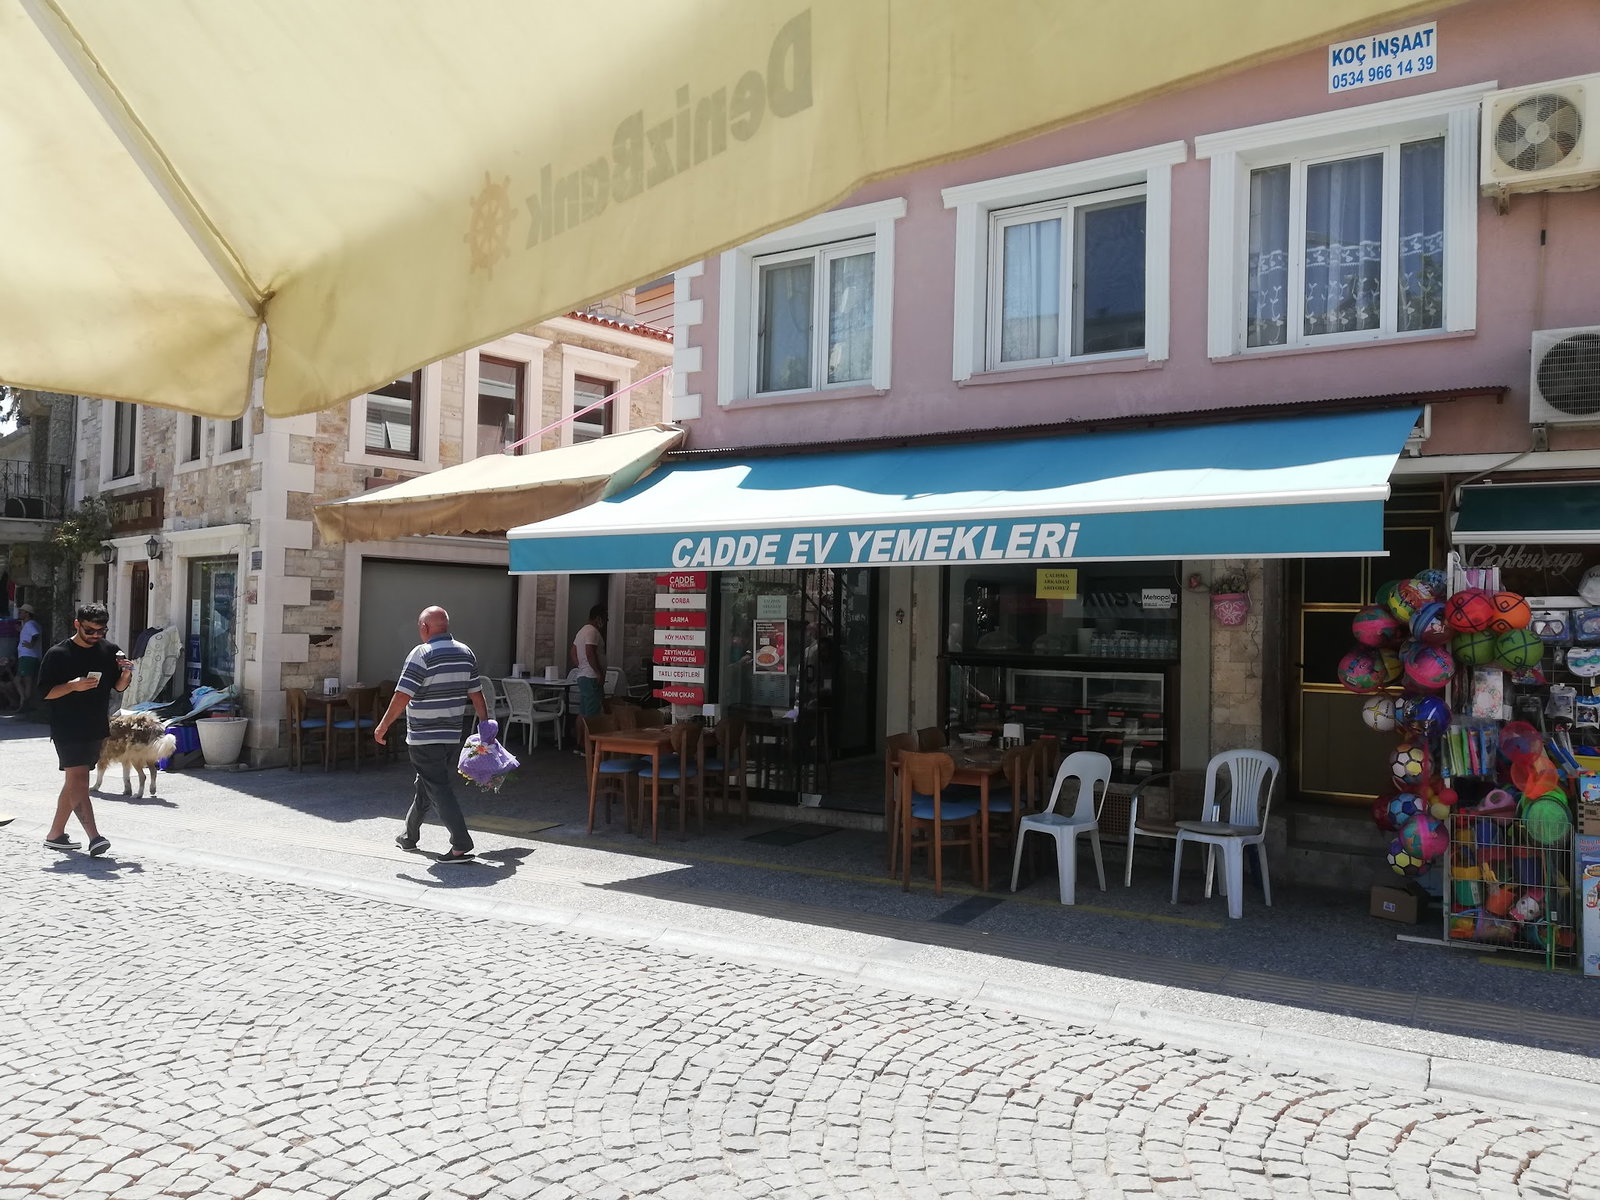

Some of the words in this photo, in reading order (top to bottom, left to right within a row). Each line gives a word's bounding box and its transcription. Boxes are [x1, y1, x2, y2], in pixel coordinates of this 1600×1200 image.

[1332, 45, 1366, 66] KOÇ
[1372, 29, 1434, 59] İNŞAAT
[1332, 70, 1364, 89] 0534
[1368, 64, 1392, 82] 966
[1397, 59, 1413, 76] 14
[1417, 55, 1434, 72] 39
[672, 534, 782, 568] CADDE
[786, 532, 839, 564] EV
[669, 576, 695, 584] CADDE
